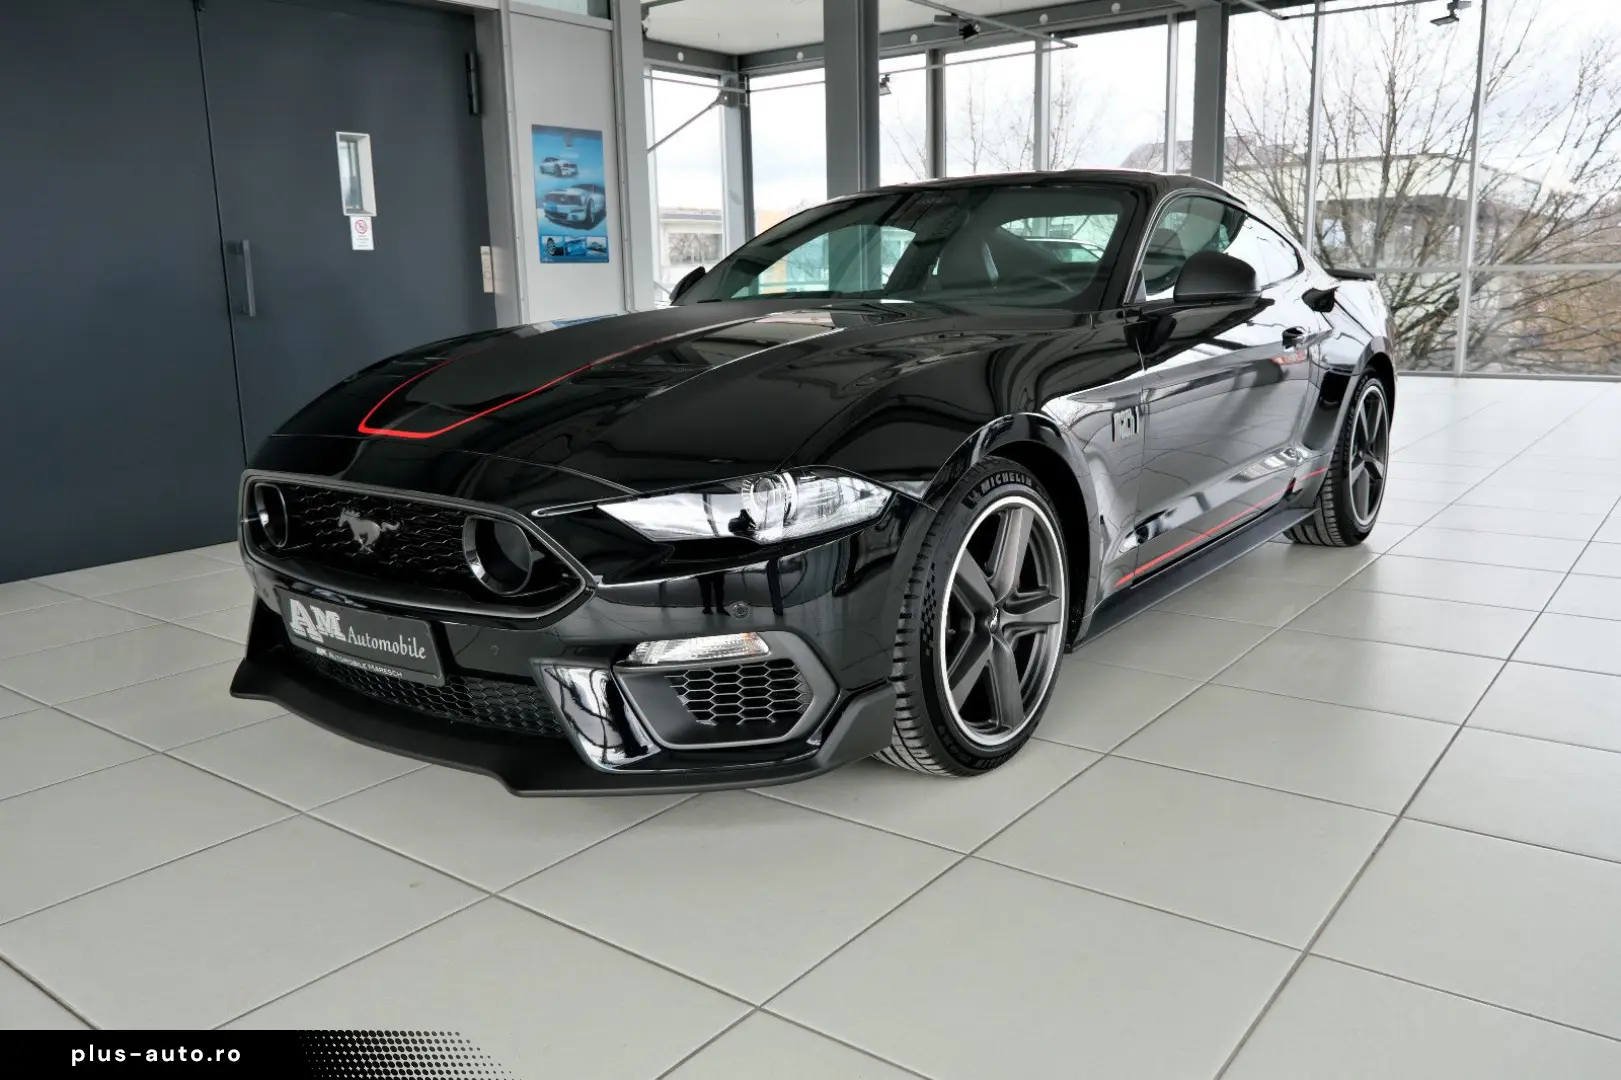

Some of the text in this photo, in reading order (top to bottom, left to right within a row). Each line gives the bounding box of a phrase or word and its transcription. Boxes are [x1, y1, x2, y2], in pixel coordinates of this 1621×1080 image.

[981, 472, 1032, 494] MICHELIN
[290, 599, 427, 660] AM Automobile
[368, 663, 403, 678] MARESCH
